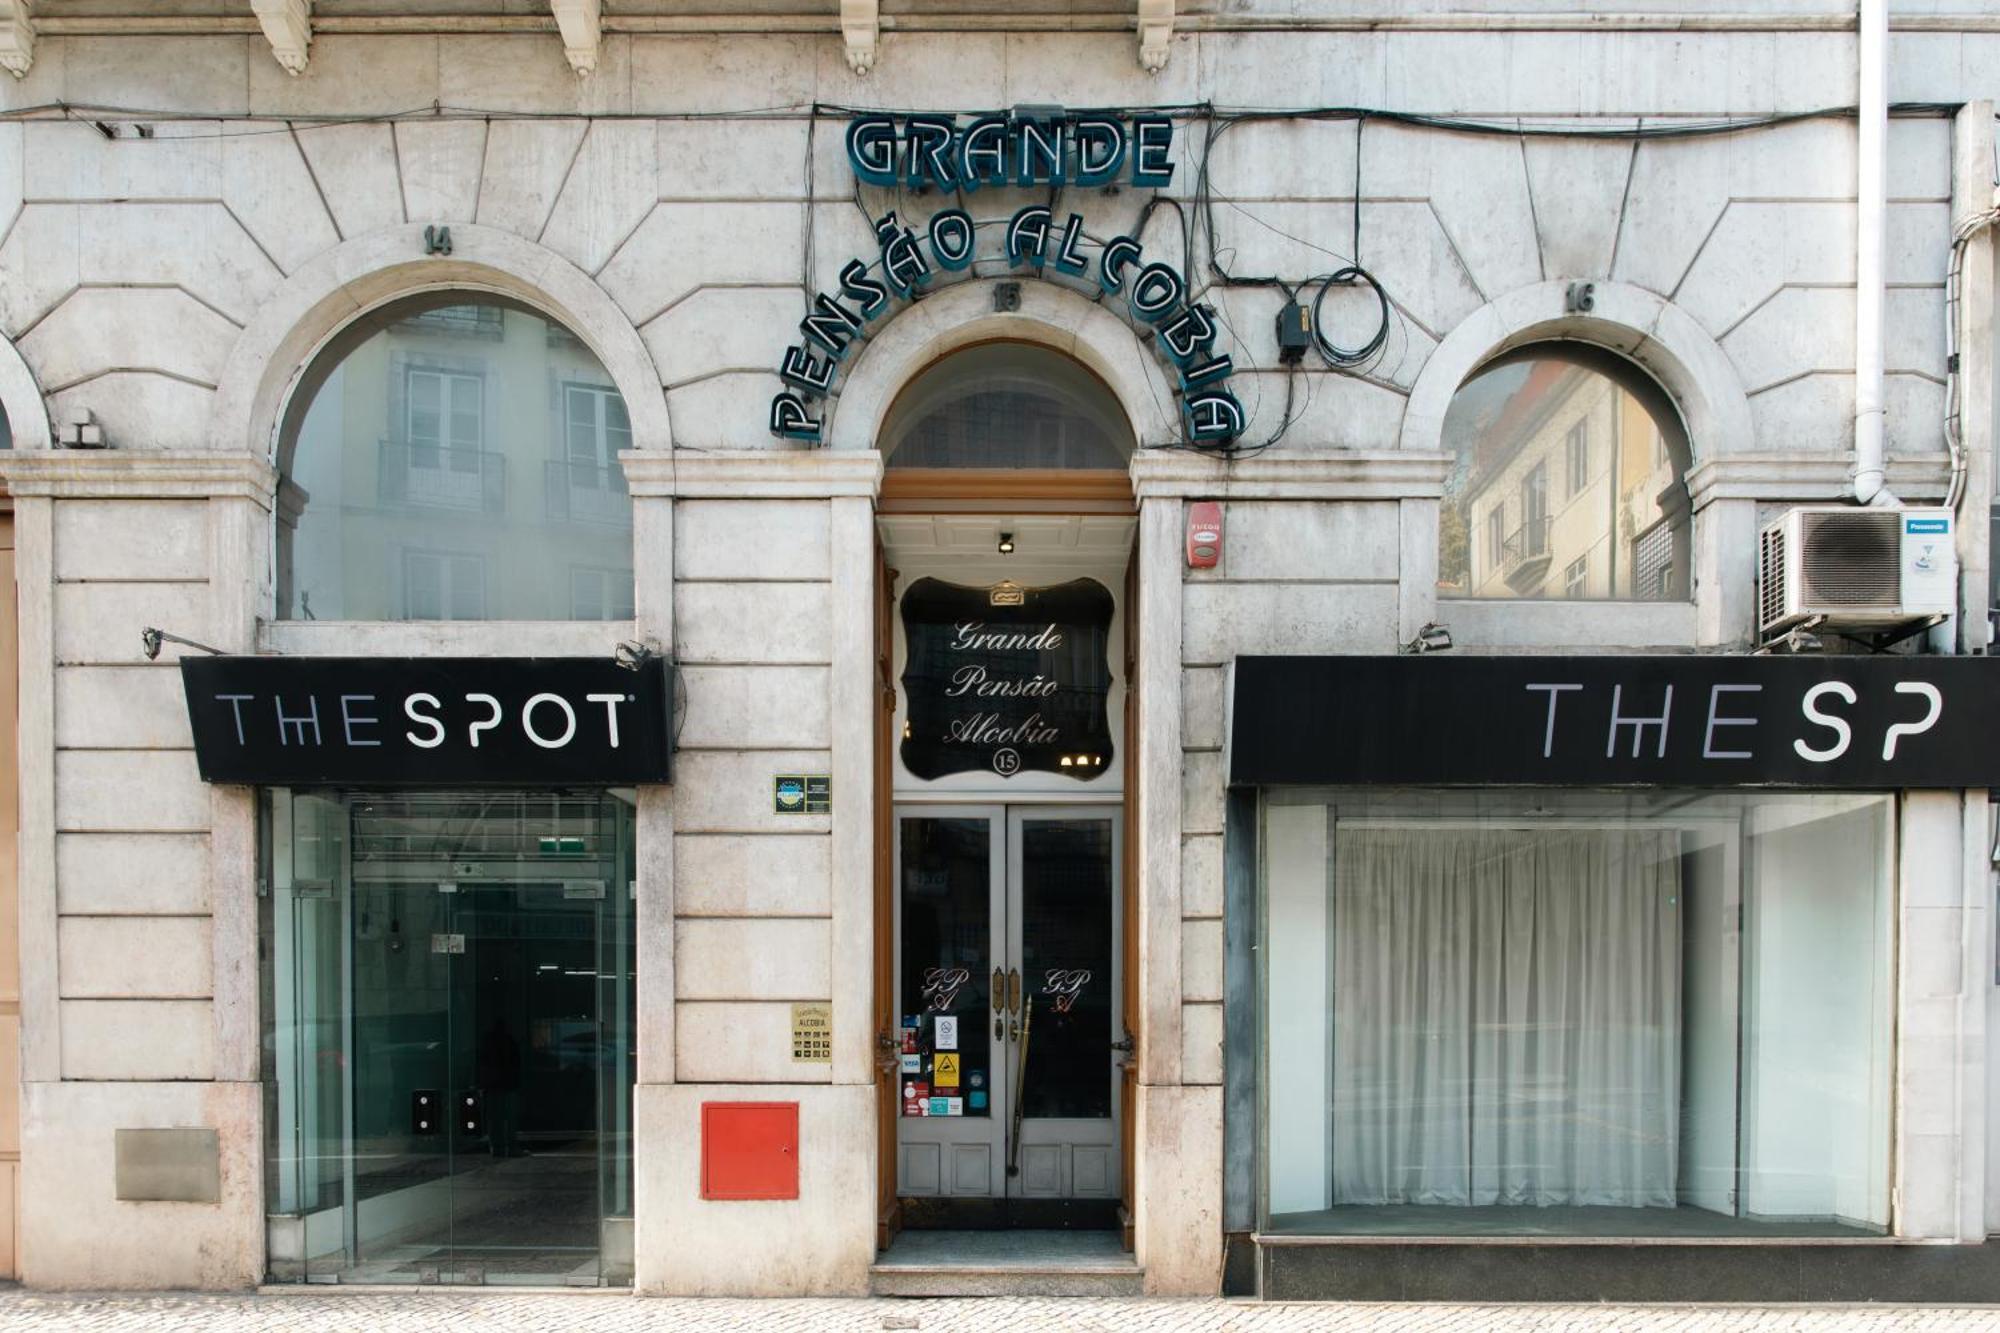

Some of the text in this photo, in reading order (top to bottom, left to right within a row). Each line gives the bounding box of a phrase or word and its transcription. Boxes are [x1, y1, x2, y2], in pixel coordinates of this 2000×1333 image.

[846, 114, 1175, 195] GRANDE
[424, 225, 452, 256] 14
[1566, 282, 1594, 312] 16
[769, 205, 1245, 441] PENSÃO ALCOBIA
[951, 621, 1062, 650] Grande
[945, 664, 1058, 697] Pensão
[215, 693, 626, 749] THE SPOT
[943, 712, 1060, 744] Alcobia
[1525, 683, 1763, 759] THE
[999, 755, 1016, 769] 15
